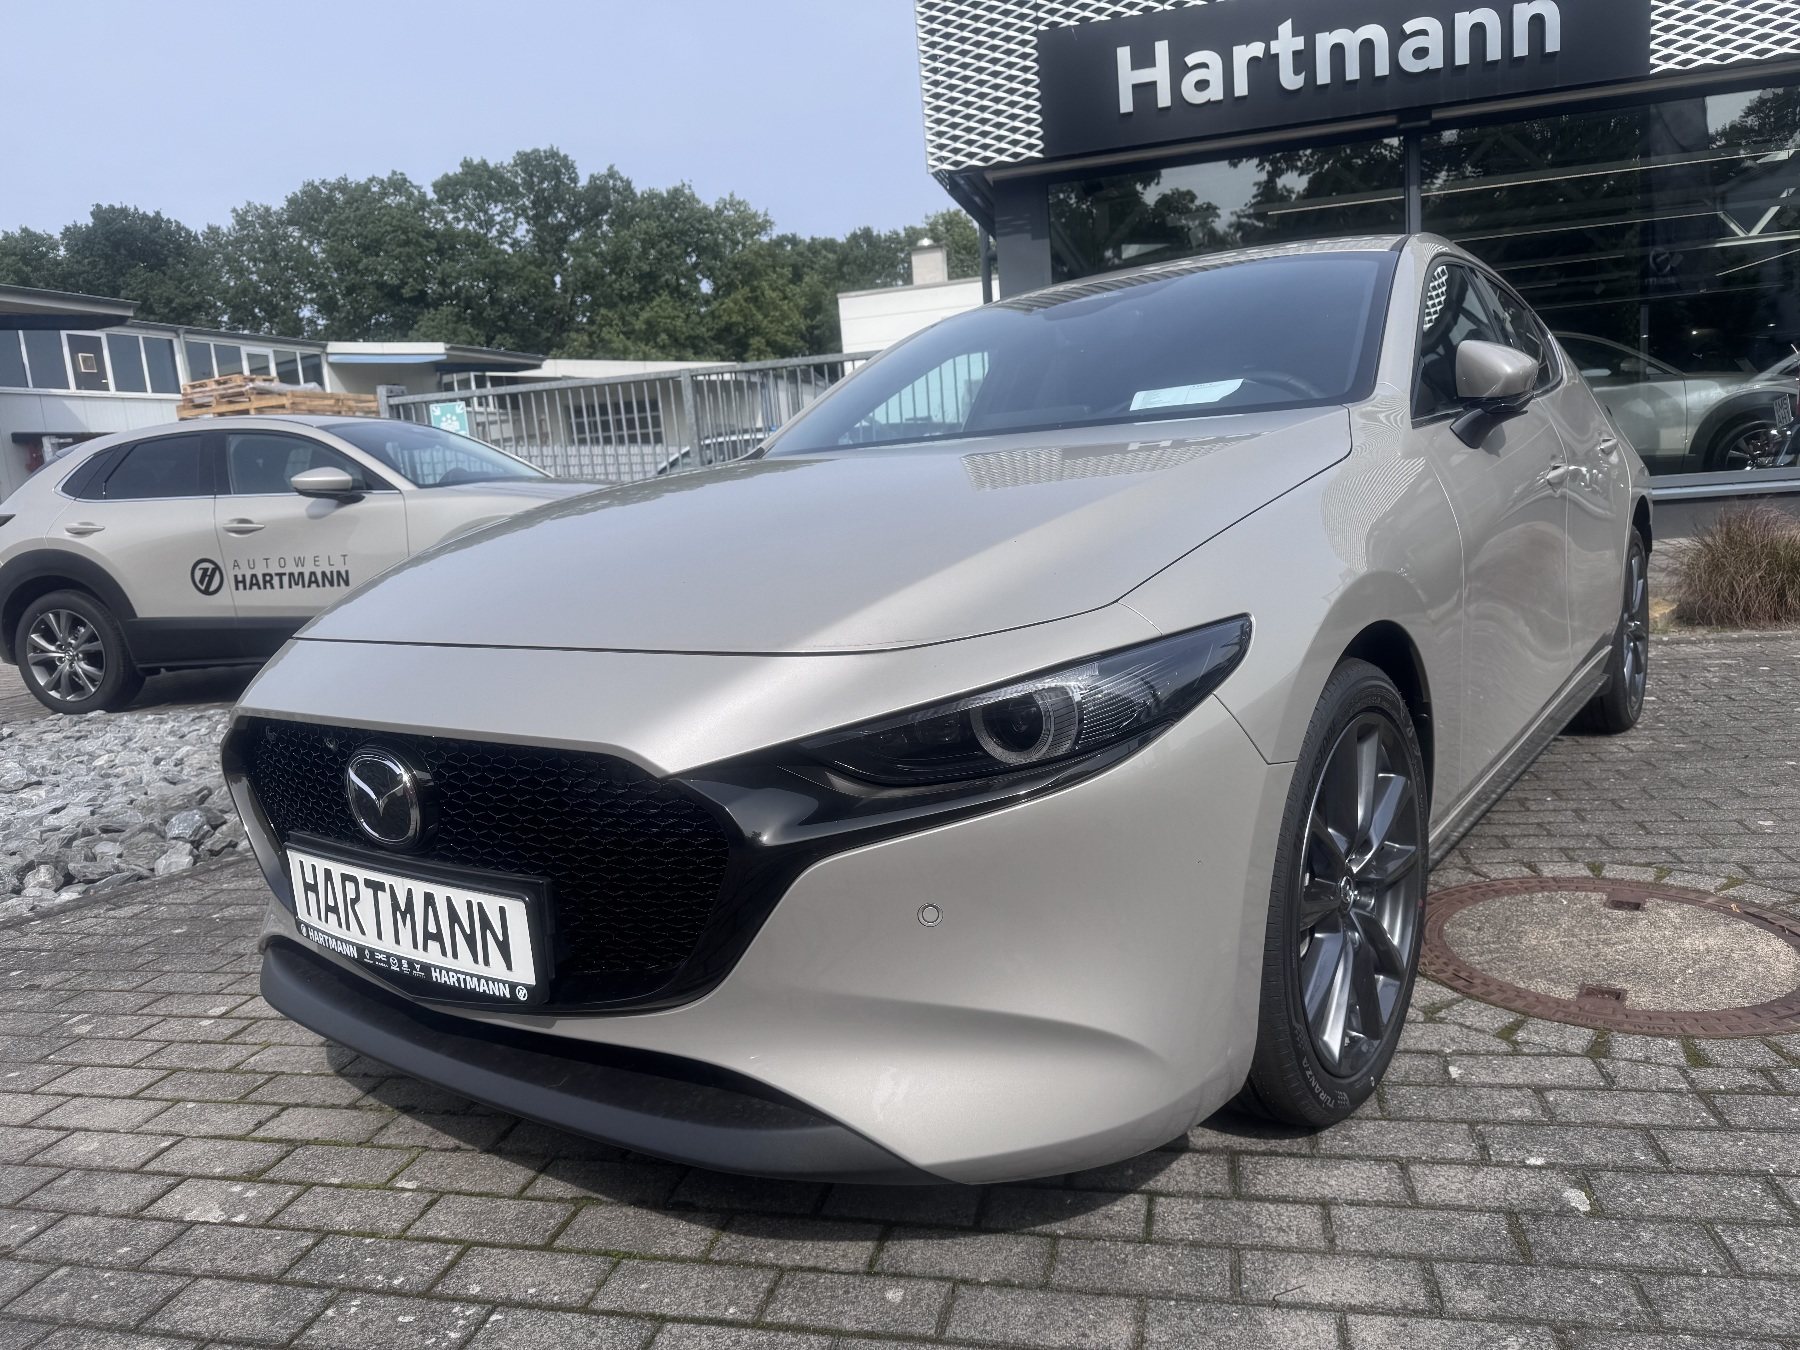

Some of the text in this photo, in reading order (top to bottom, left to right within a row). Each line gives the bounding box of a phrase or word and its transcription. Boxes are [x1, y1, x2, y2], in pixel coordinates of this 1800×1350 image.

[1116, 0, 1561, 114] Hartmann
[233, 554, 348, 570] AUTOWELT
[233, 569, 350, 591] HARTMANN
[299, 859, 513, 972] HARTMANN
[308, 928, 358, 959] HARTMANN
[430, 967, 511, 999] HARTMANN
[1302, 1055, 1335, 1109] TURANZA
